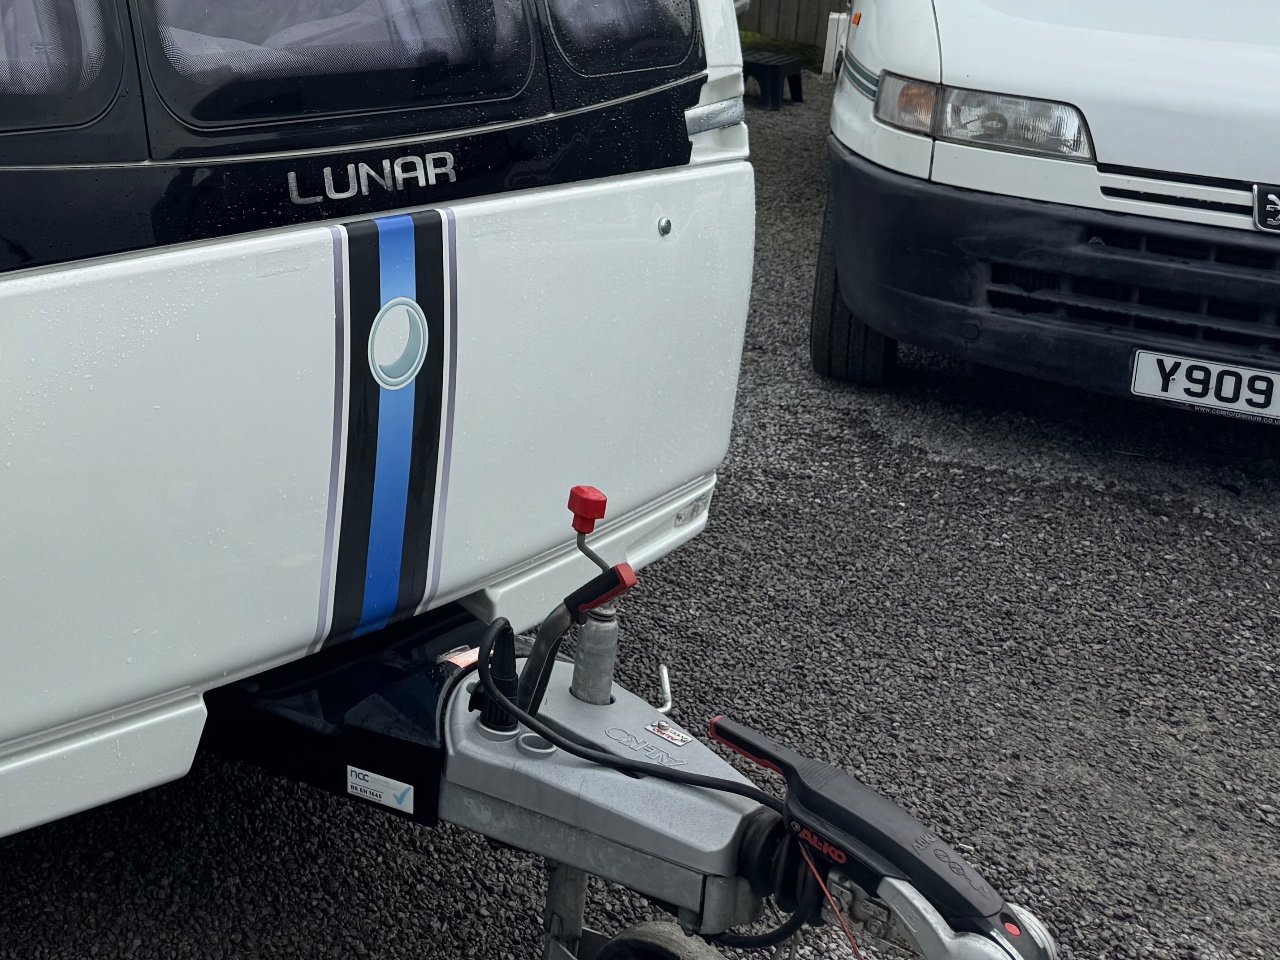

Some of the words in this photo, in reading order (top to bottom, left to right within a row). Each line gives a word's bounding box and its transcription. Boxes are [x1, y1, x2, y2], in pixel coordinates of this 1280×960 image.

[287, 151, 457, 205] LUNAR
[1156, 358, 1274, 409] Y909
[350, 769, 369, 782] ncc
